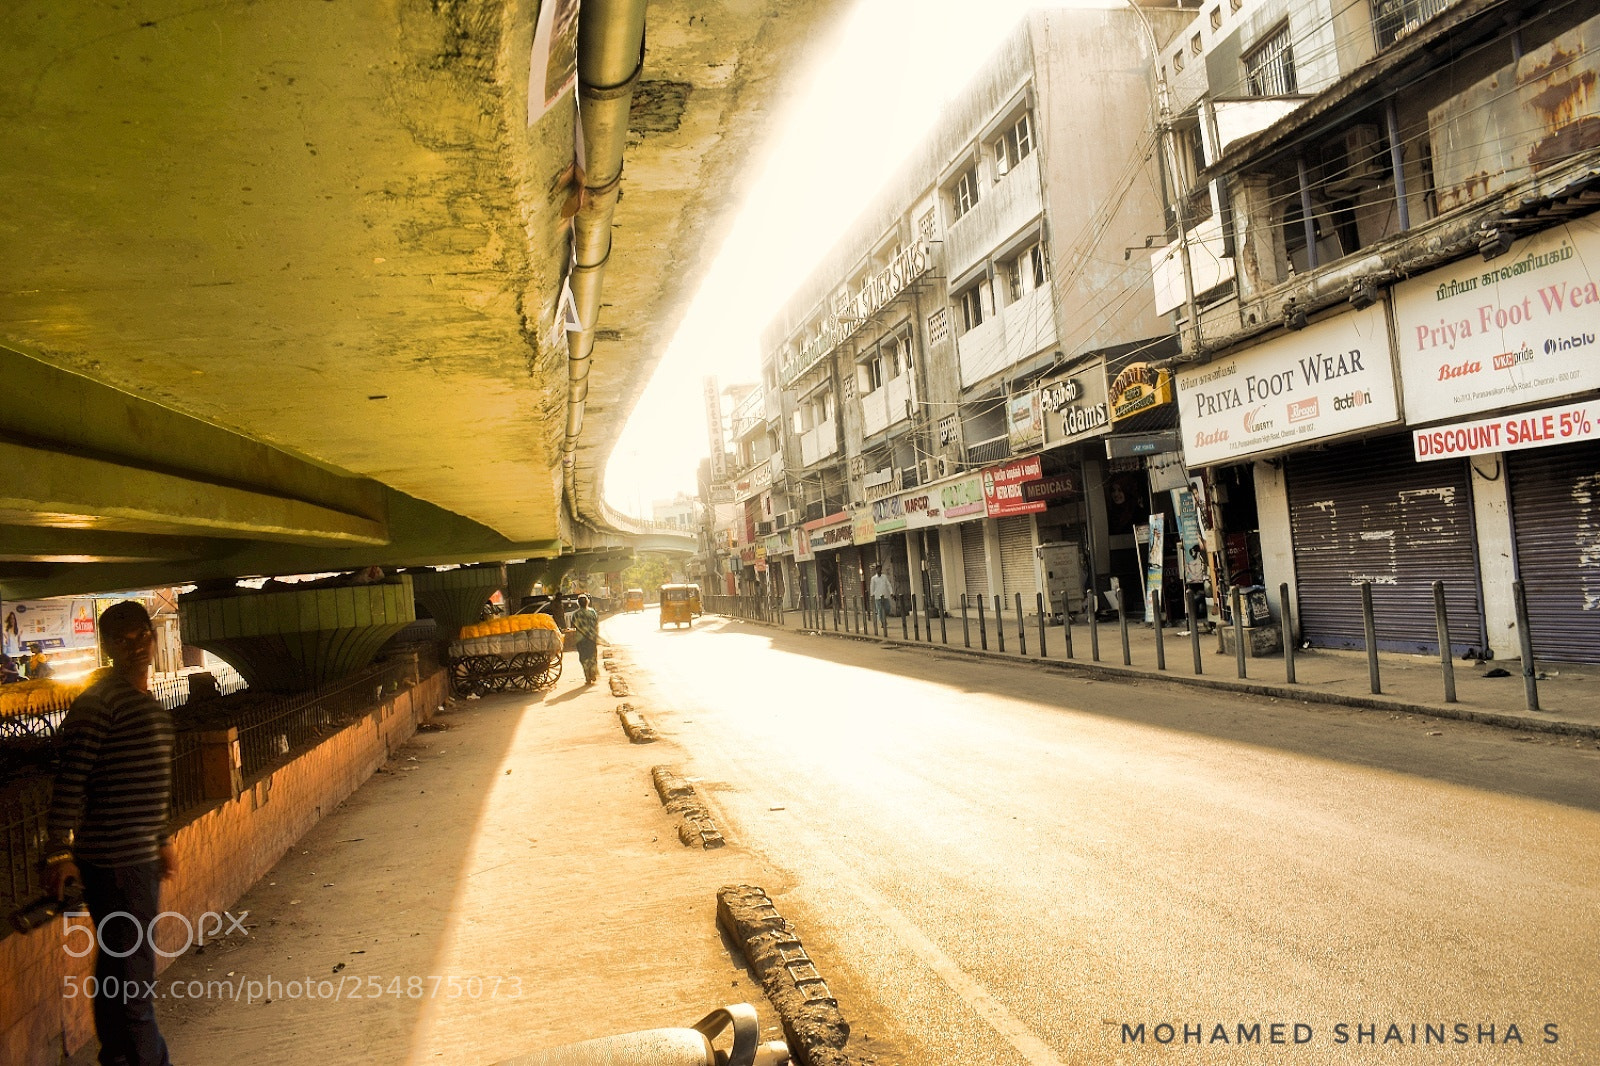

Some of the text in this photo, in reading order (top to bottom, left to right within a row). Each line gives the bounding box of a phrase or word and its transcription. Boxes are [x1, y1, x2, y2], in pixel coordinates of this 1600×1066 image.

[1436, 240, 1573, 301] பிரியா காலணியகம்
[1415, 281, 1600, 351] Priya Foot Wea
[1558, 333, 1596, 352] inblu
[1195, 387, 1243, 418] PRIYA
[1245, 370, 1294, 403] FOOT
[1299, 349, 1365, 386] WEAR
[1438, 360, 1483, 382] Bata
[1060, 403, 1106, 436] Adams
[1418, 409, 1591, 456] DISCOUNT SALE 5%
[1194, 428, 1229, 448] Bata
[1027, 479, 1073, 498] MEDICALS
